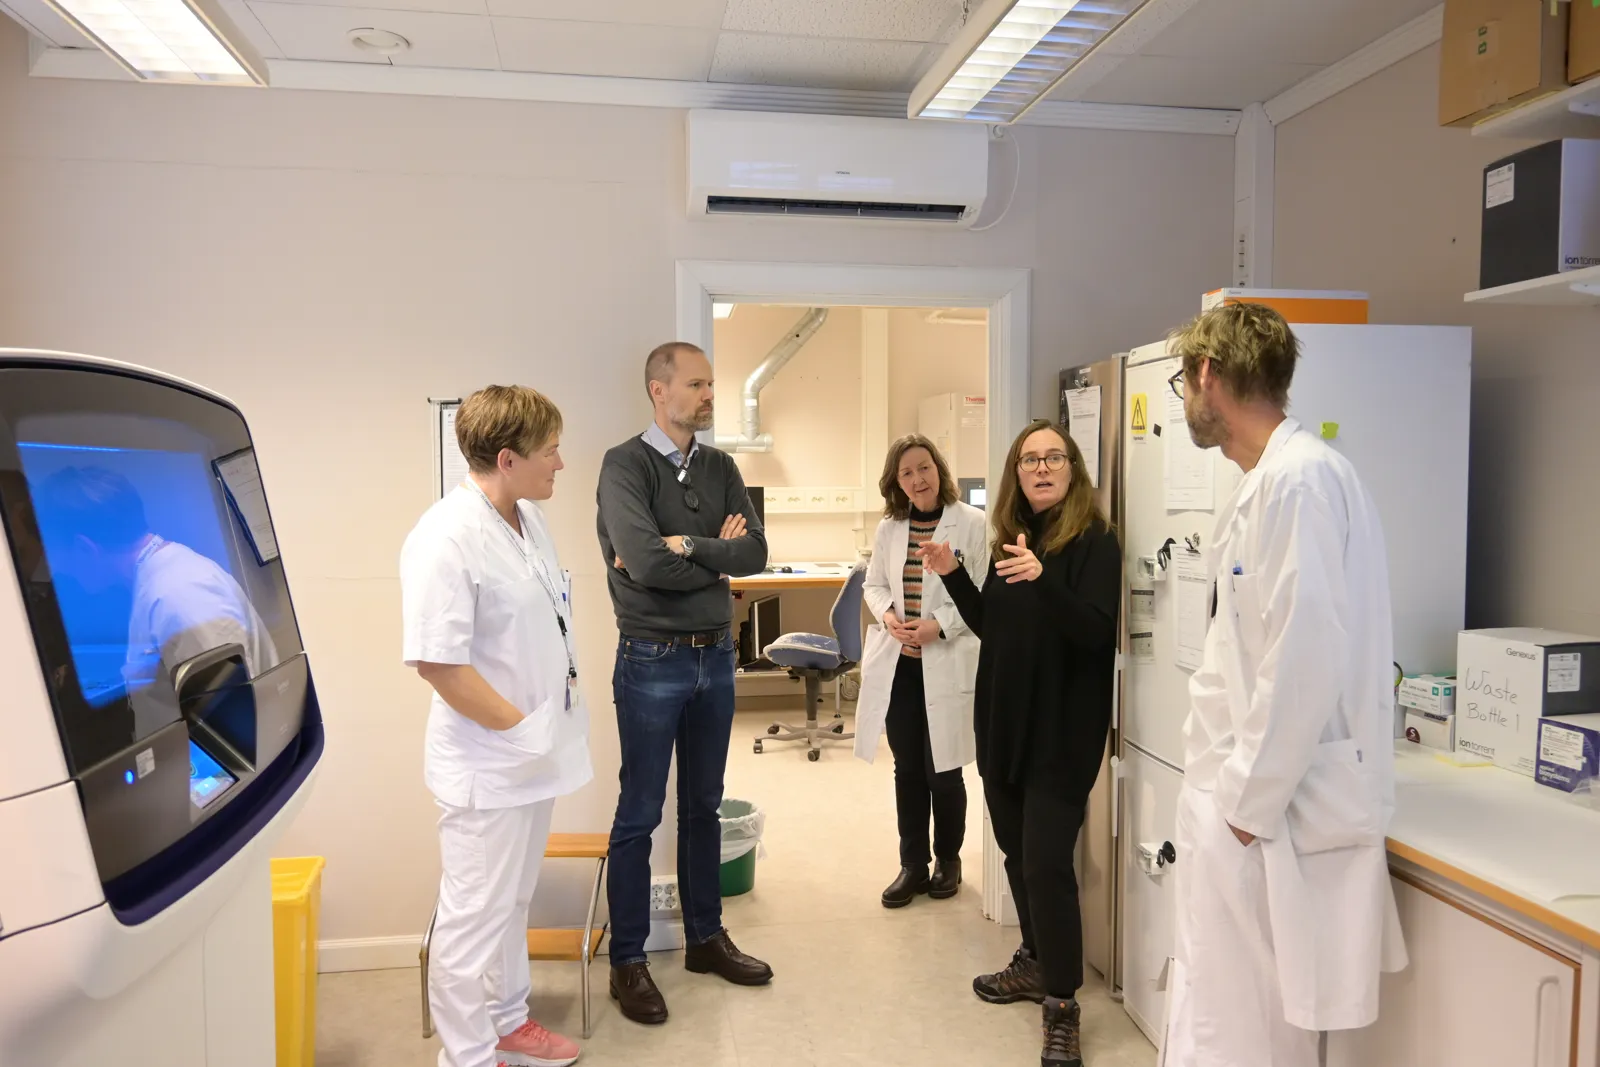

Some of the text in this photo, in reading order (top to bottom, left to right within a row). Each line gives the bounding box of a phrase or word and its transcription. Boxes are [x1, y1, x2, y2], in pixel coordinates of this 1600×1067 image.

[1565, 254, 1579, 264] ion
[1465, 667, 1518, 705] Waste
[1466, 702, 1508, 728] Bottle
[1410, 728, 1416, 737] S
[1459, 737, 1471, 748] ion
[1471, 741, 1495, 756] torrent
